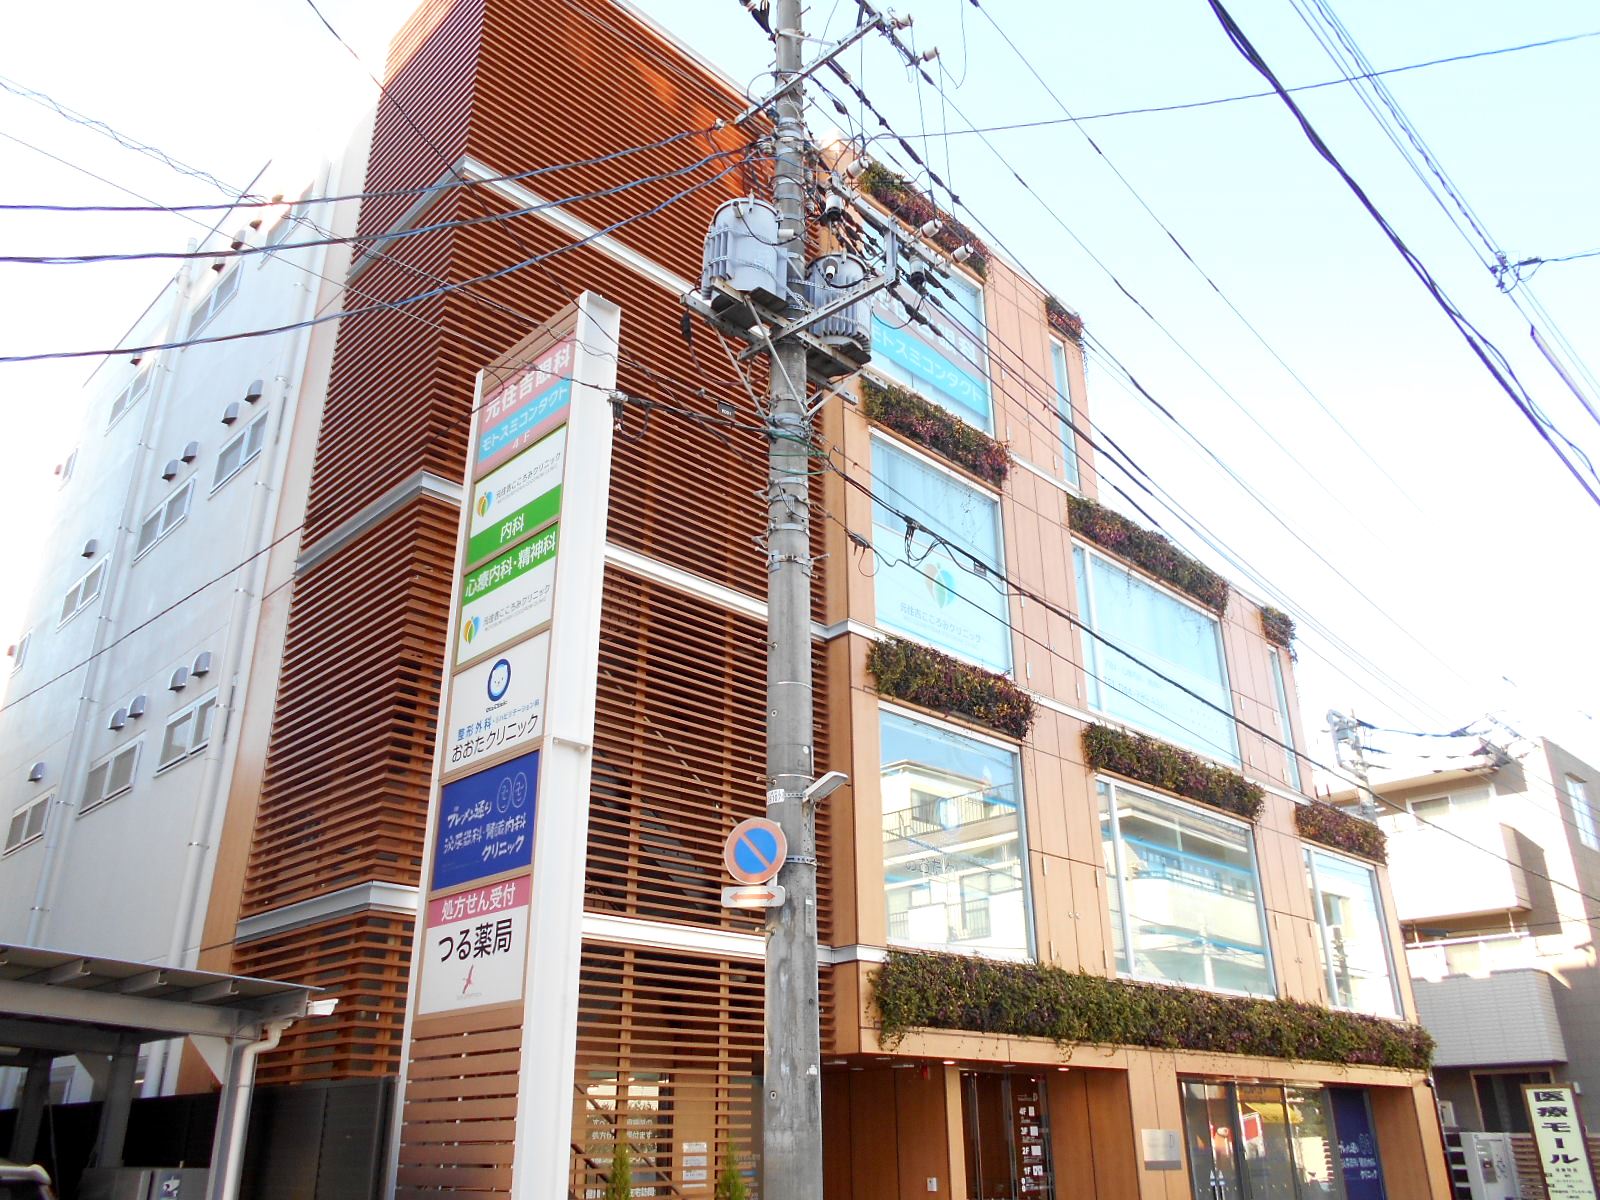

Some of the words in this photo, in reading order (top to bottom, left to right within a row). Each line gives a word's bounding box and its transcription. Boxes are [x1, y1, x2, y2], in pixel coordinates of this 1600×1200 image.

[482, 387, 569, 451] モトスミコンタクト
[500, 513, 525, 543] 内科
[465, 531, 556, 597] 心療内科・精神科
[452, 714, 539, 763] おおたクリニック
[482, 835, 525, 862] クリニック
[441, 882, 516, 921] 処方せん受付
[438, 918, 513, 963] つる薬局
[1534, 1091, 1580, 1164] 医療モール
